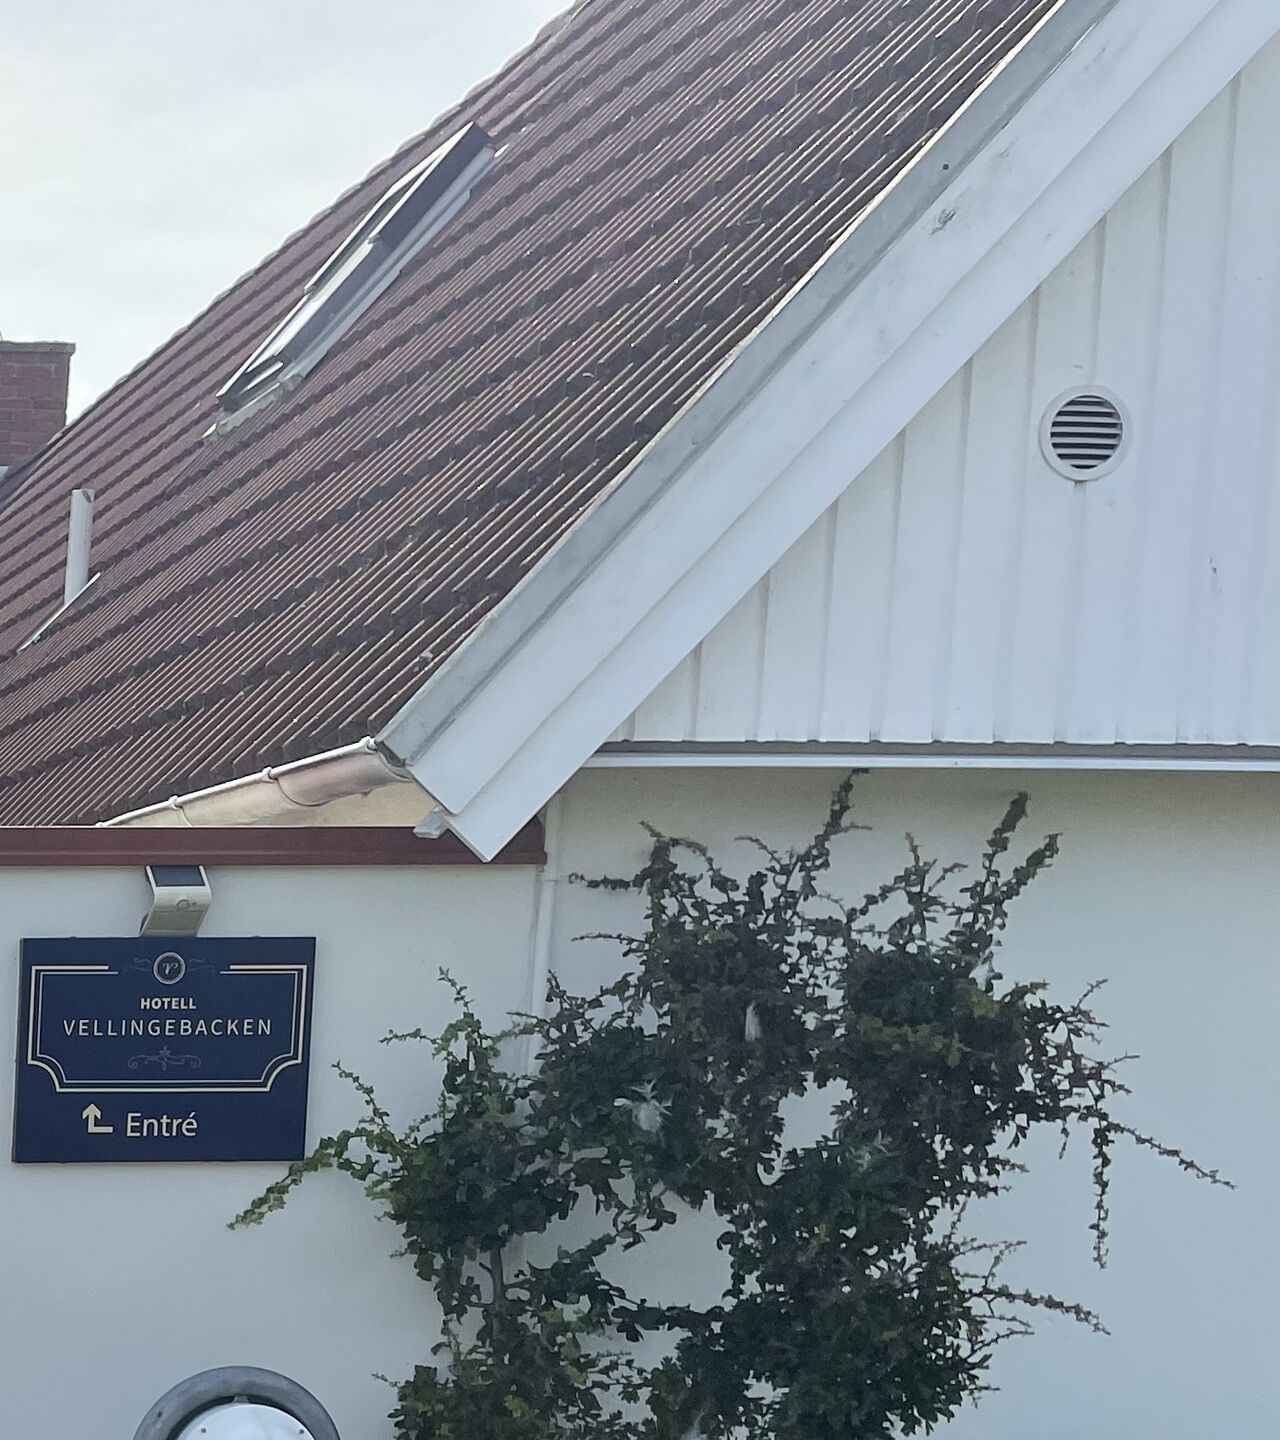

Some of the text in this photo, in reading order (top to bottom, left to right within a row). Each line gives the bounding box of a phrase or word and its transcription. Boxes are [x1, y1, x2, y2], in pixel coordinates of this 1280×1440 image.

[140, 997, 197, 1010] HOTELL
[63, 1018, 272, 1036] VELLINGEBACKEN
[126, 1111, 198, 1137] Entré
